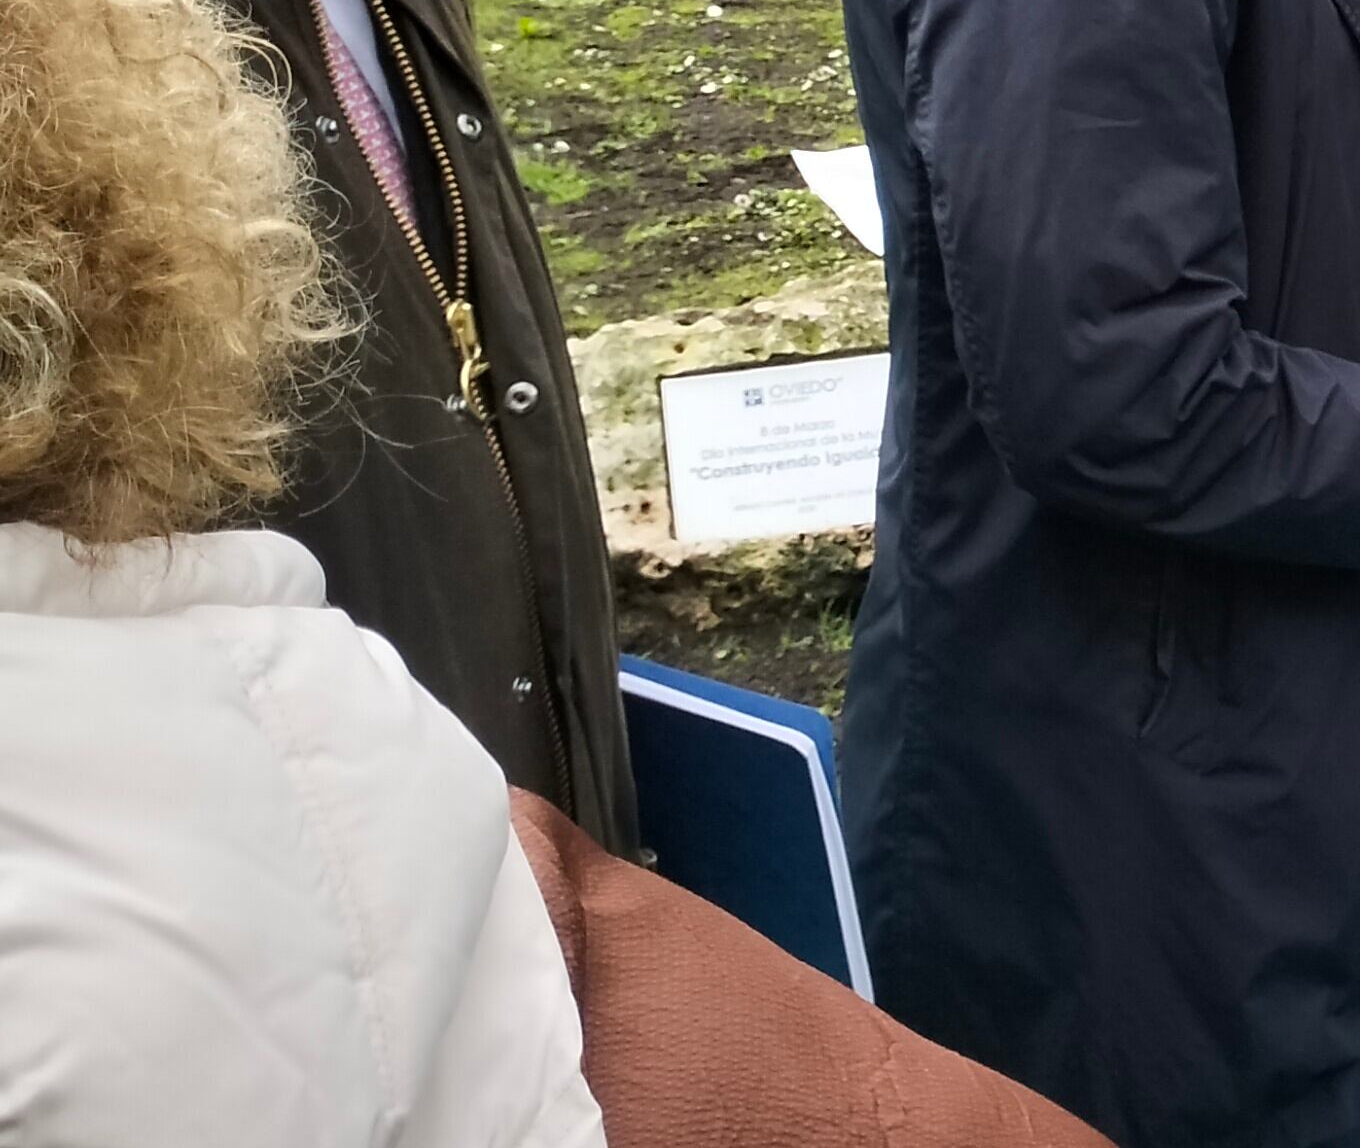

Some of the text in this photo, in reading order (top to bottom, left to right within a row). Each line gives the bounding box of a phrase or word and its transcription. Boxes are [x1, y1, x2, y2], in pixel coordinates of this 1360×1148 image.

[768, 377, 838, 399] OVIEDO
[760, 420, 836, 437] 8 de Marzo
[820, 435, 839, 446] de
[841, 432, 856, 443] la
